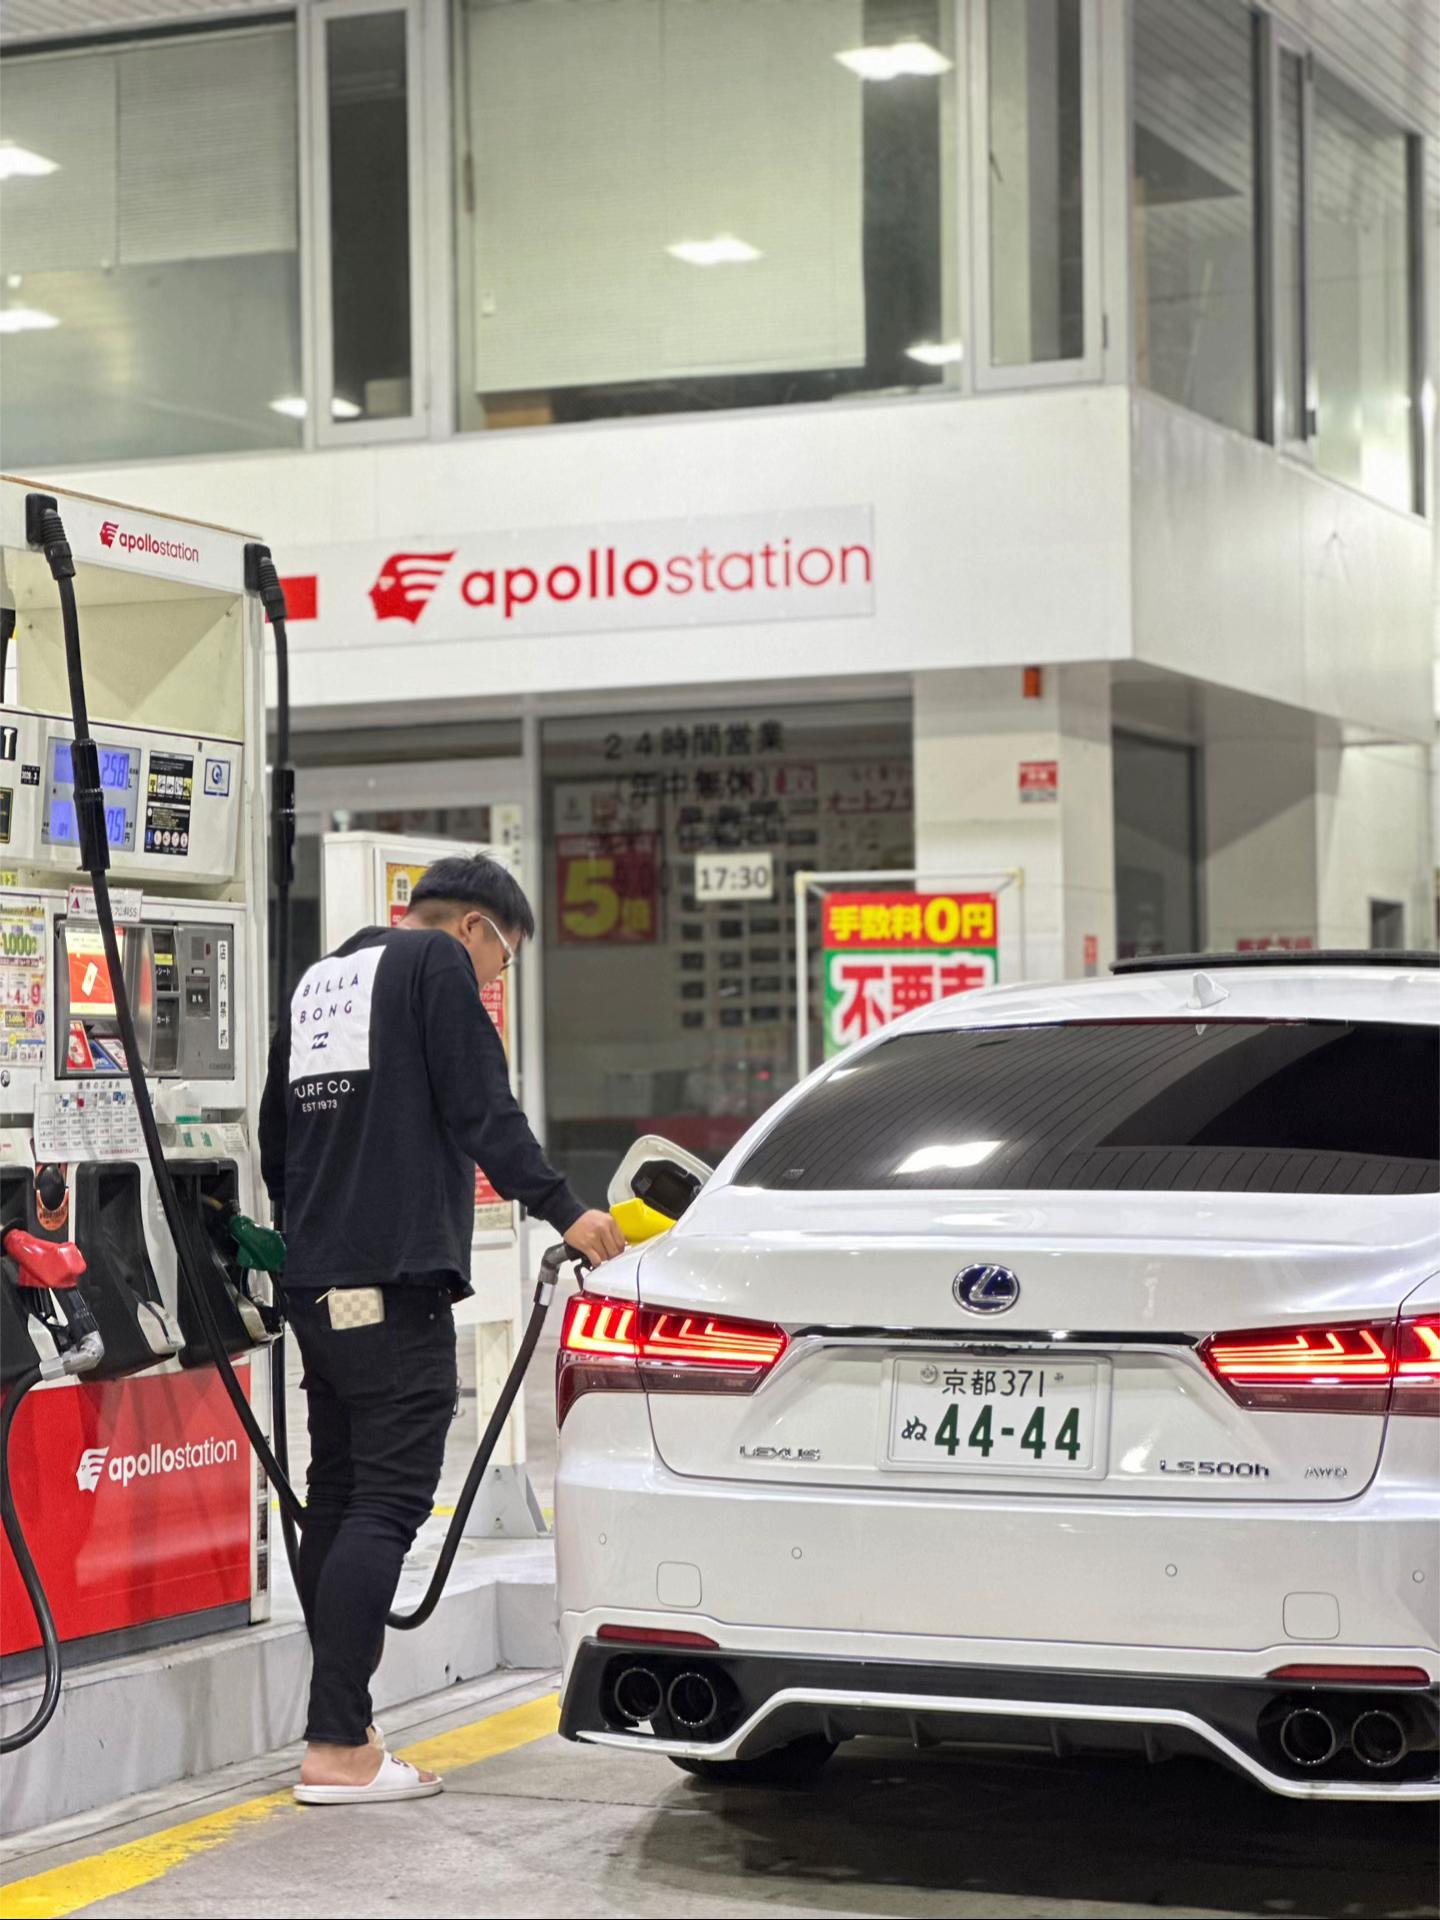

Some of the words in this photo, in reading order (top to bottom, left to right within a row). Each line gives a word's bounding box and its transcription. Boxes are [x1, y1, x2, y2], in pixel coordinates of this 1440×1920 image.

[119, 532, 199, 563] apollostation
[461, 538, 872, 618] apollostation
[700, 866, 769, 891] 17:30
[829, 897, 993, 943] 手数料0円
[303, 973, 359, 997] BILLA
[300, 1000, 353, 1024] BONG
[327, 1079, 355, 1094] CO.
[301, 1101, 317, 1113] EST
[318, 1099, 337, 1110] 1973
[901, 1415, 928, 1441] ぬ
[934, 1403, 1081, 1461] 44-44
[108, 1437, 238, 1487] apollostation
[739, 1445, 821, 1461] LEXUS
[1304, 1466, 1348, 1480] AWD
